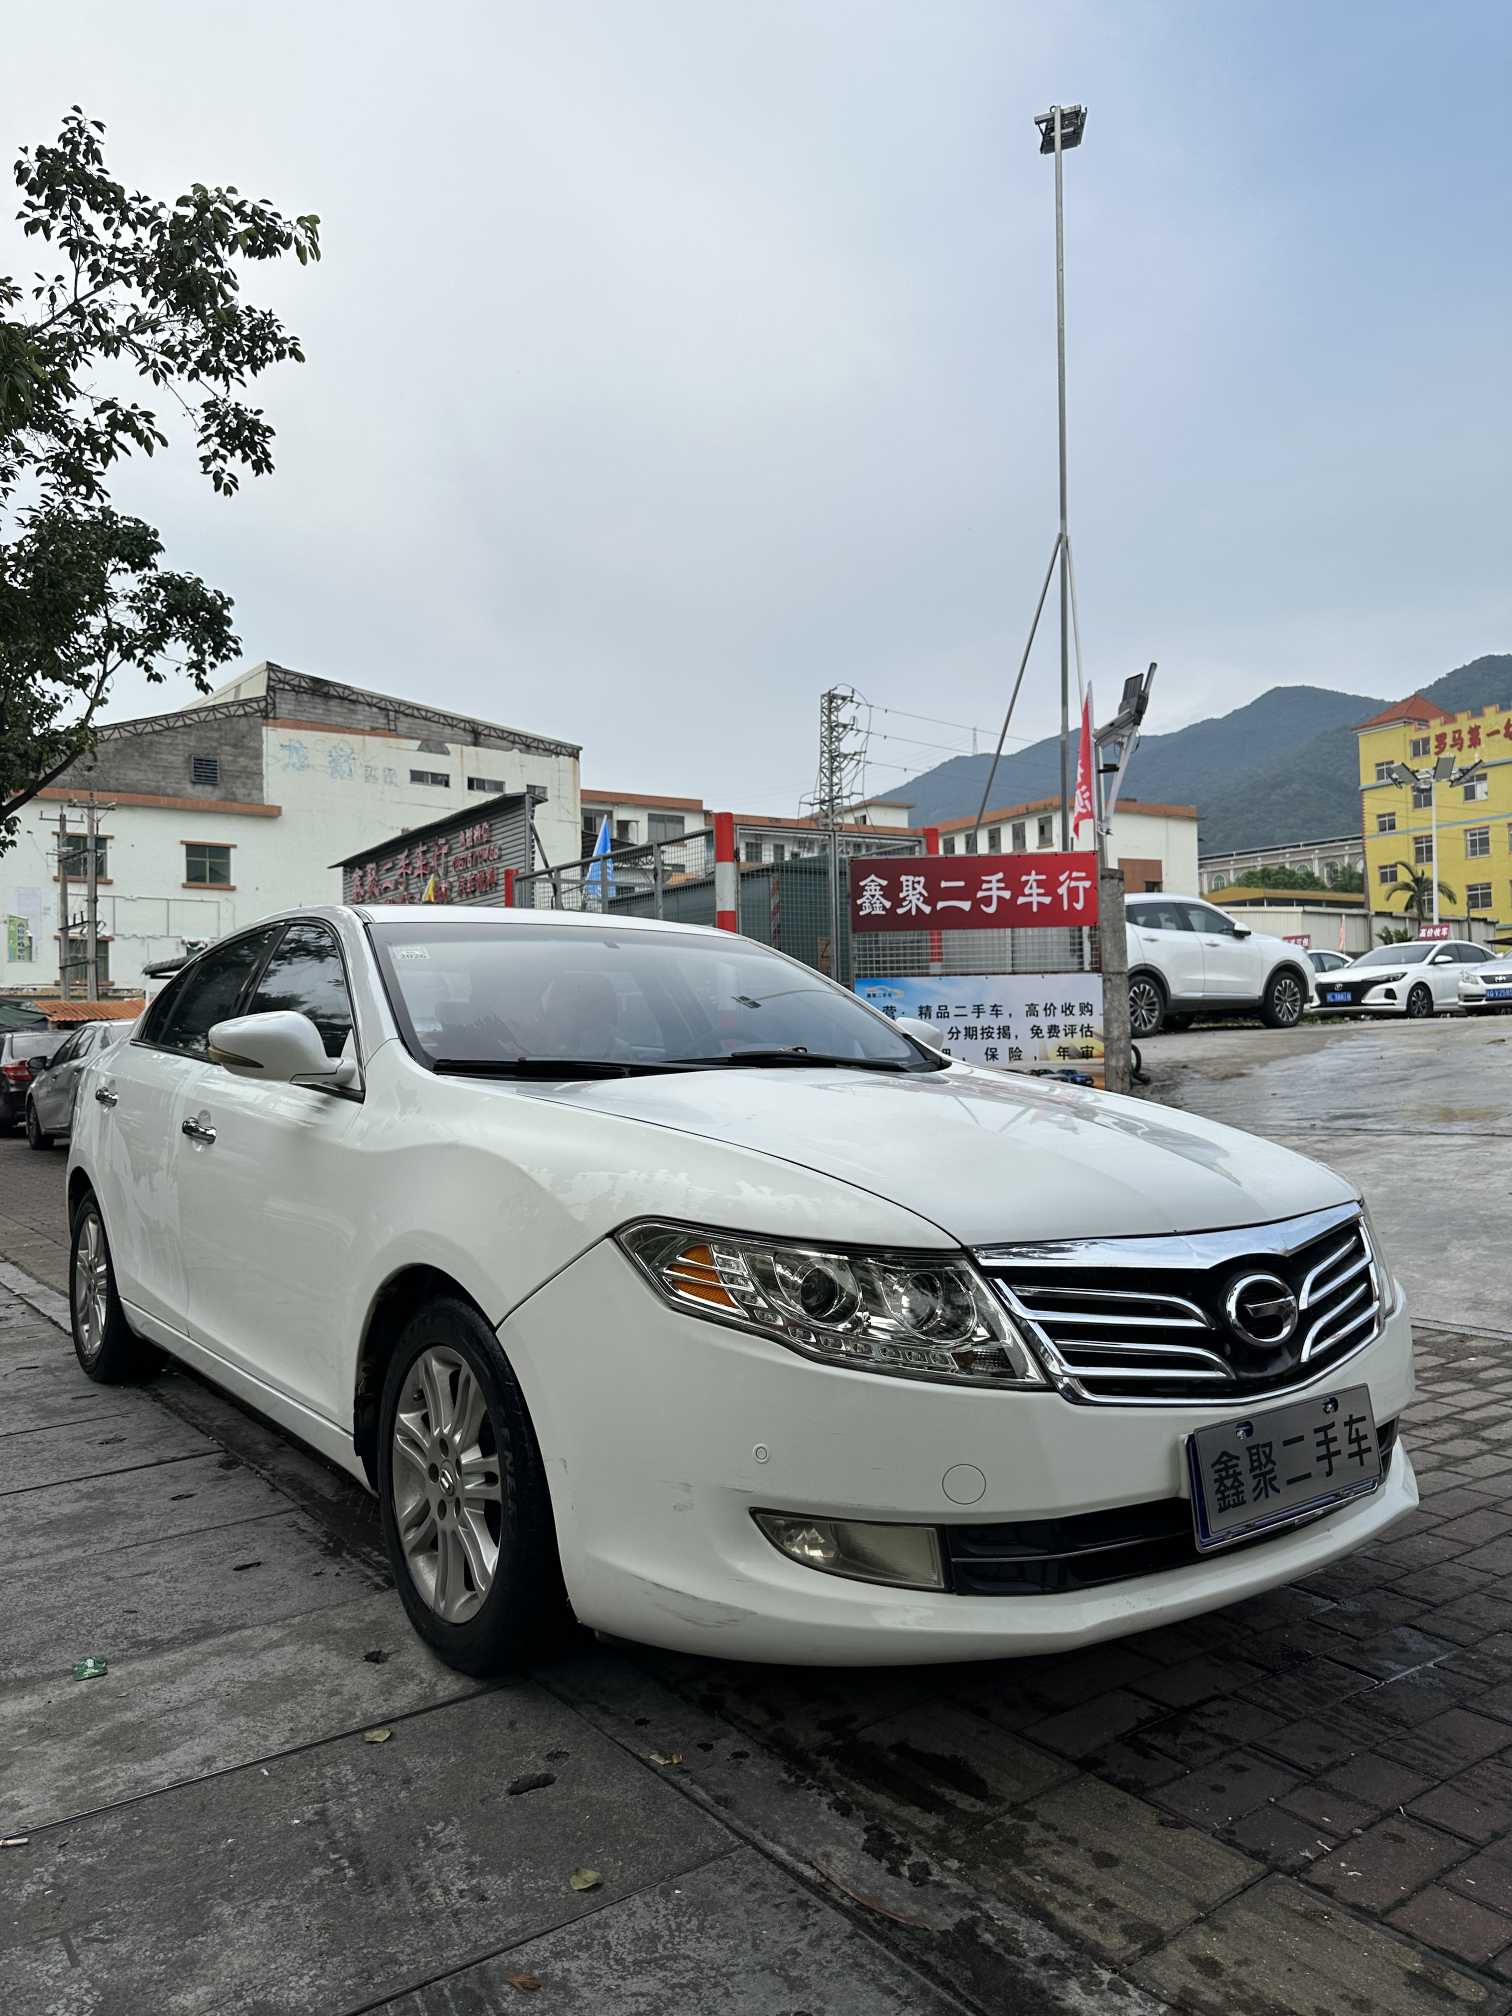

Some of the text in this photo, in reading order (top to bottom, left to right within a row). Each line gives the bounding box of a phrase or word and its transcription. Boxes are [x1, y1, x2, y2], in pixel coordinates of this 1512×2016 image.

[856, 870, 1092, 917] 鑫聚二手车行
[1211, 1414, 1374, 1513] 鑫聚二手车
